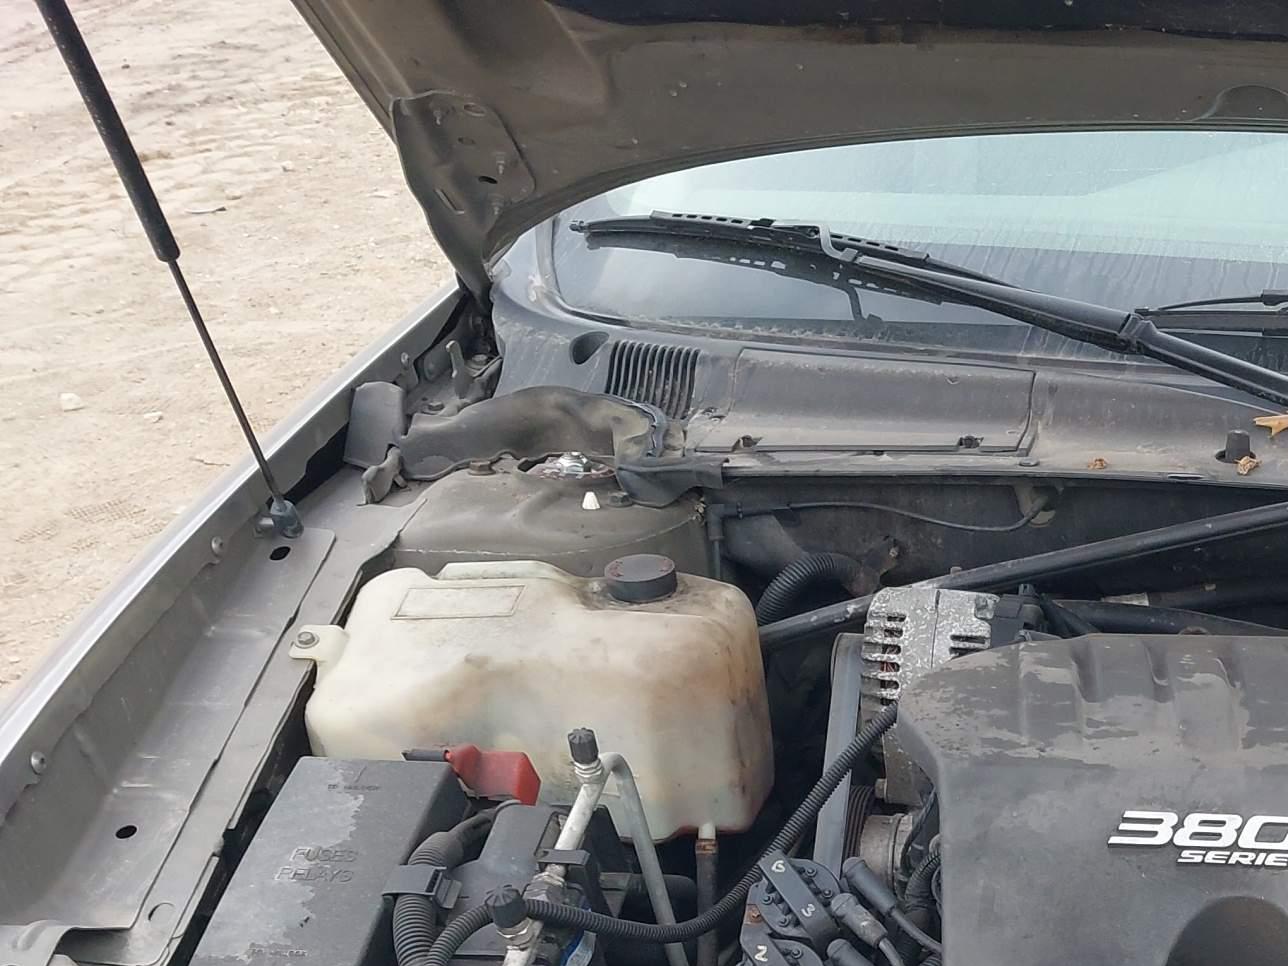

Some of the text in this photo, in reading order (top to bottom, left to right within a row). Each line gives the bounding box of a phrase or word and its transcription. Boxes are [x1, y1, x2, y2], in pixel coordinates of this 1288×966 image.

[771, 860, 786, 873] 6
[801, 903, 816, 917] 3
[755, 945, 768, 962] 2
